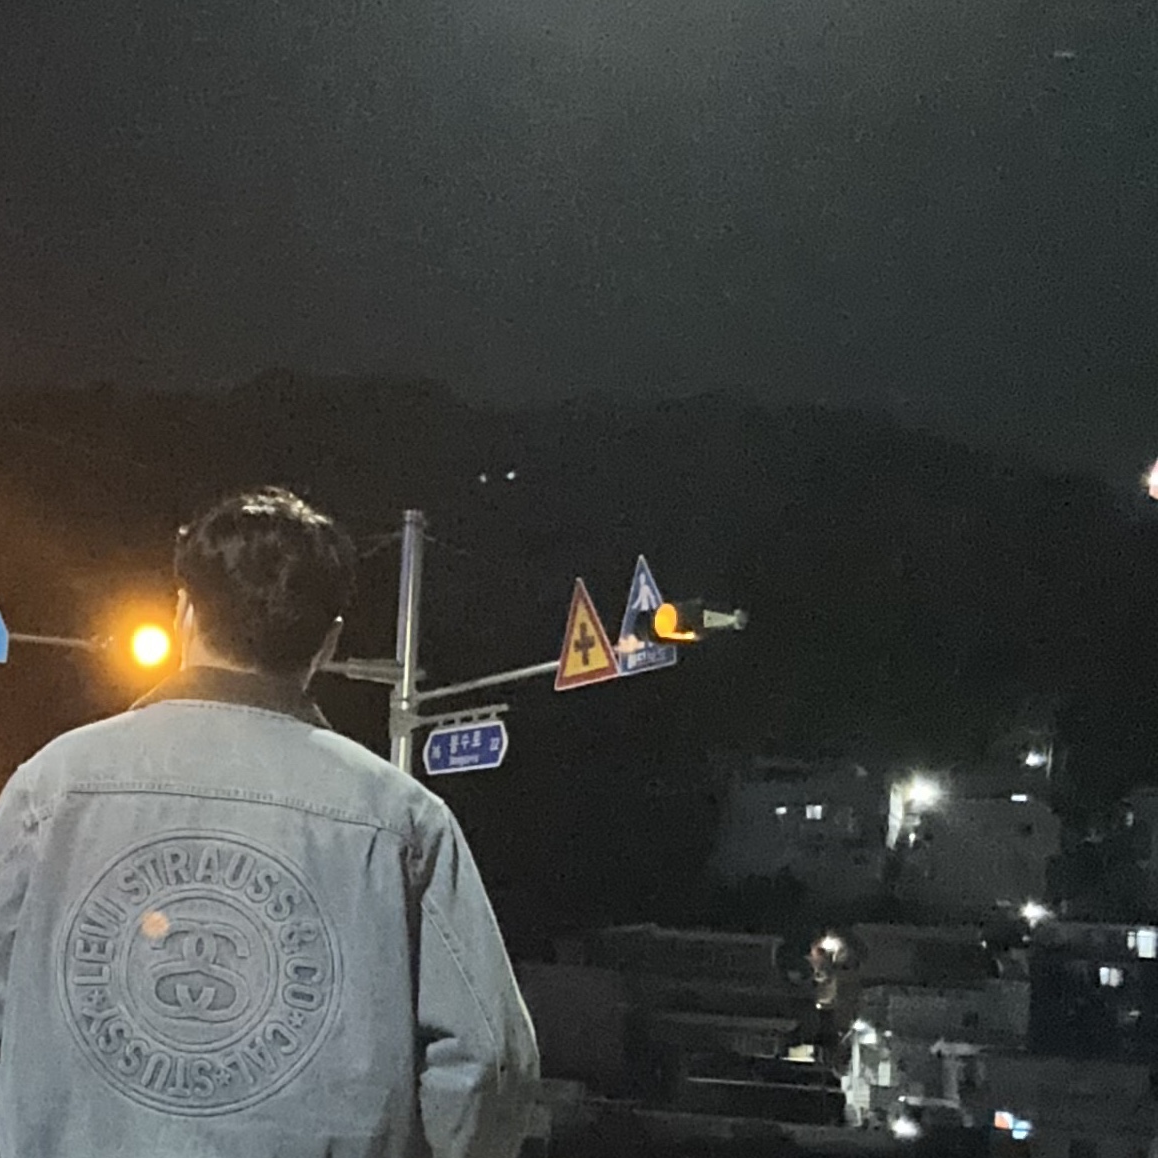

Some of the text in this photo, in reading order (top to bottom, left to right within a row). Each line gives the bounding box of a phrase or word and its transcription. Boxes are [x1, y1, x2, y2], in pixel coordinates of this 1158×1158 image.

[74, 899, 126, 987] LEVI
[119, 848, 298, 921] STRAUSS
[284, 957, 324, 1011] CO
[81, 1004, 215, 1098] STUSSY
